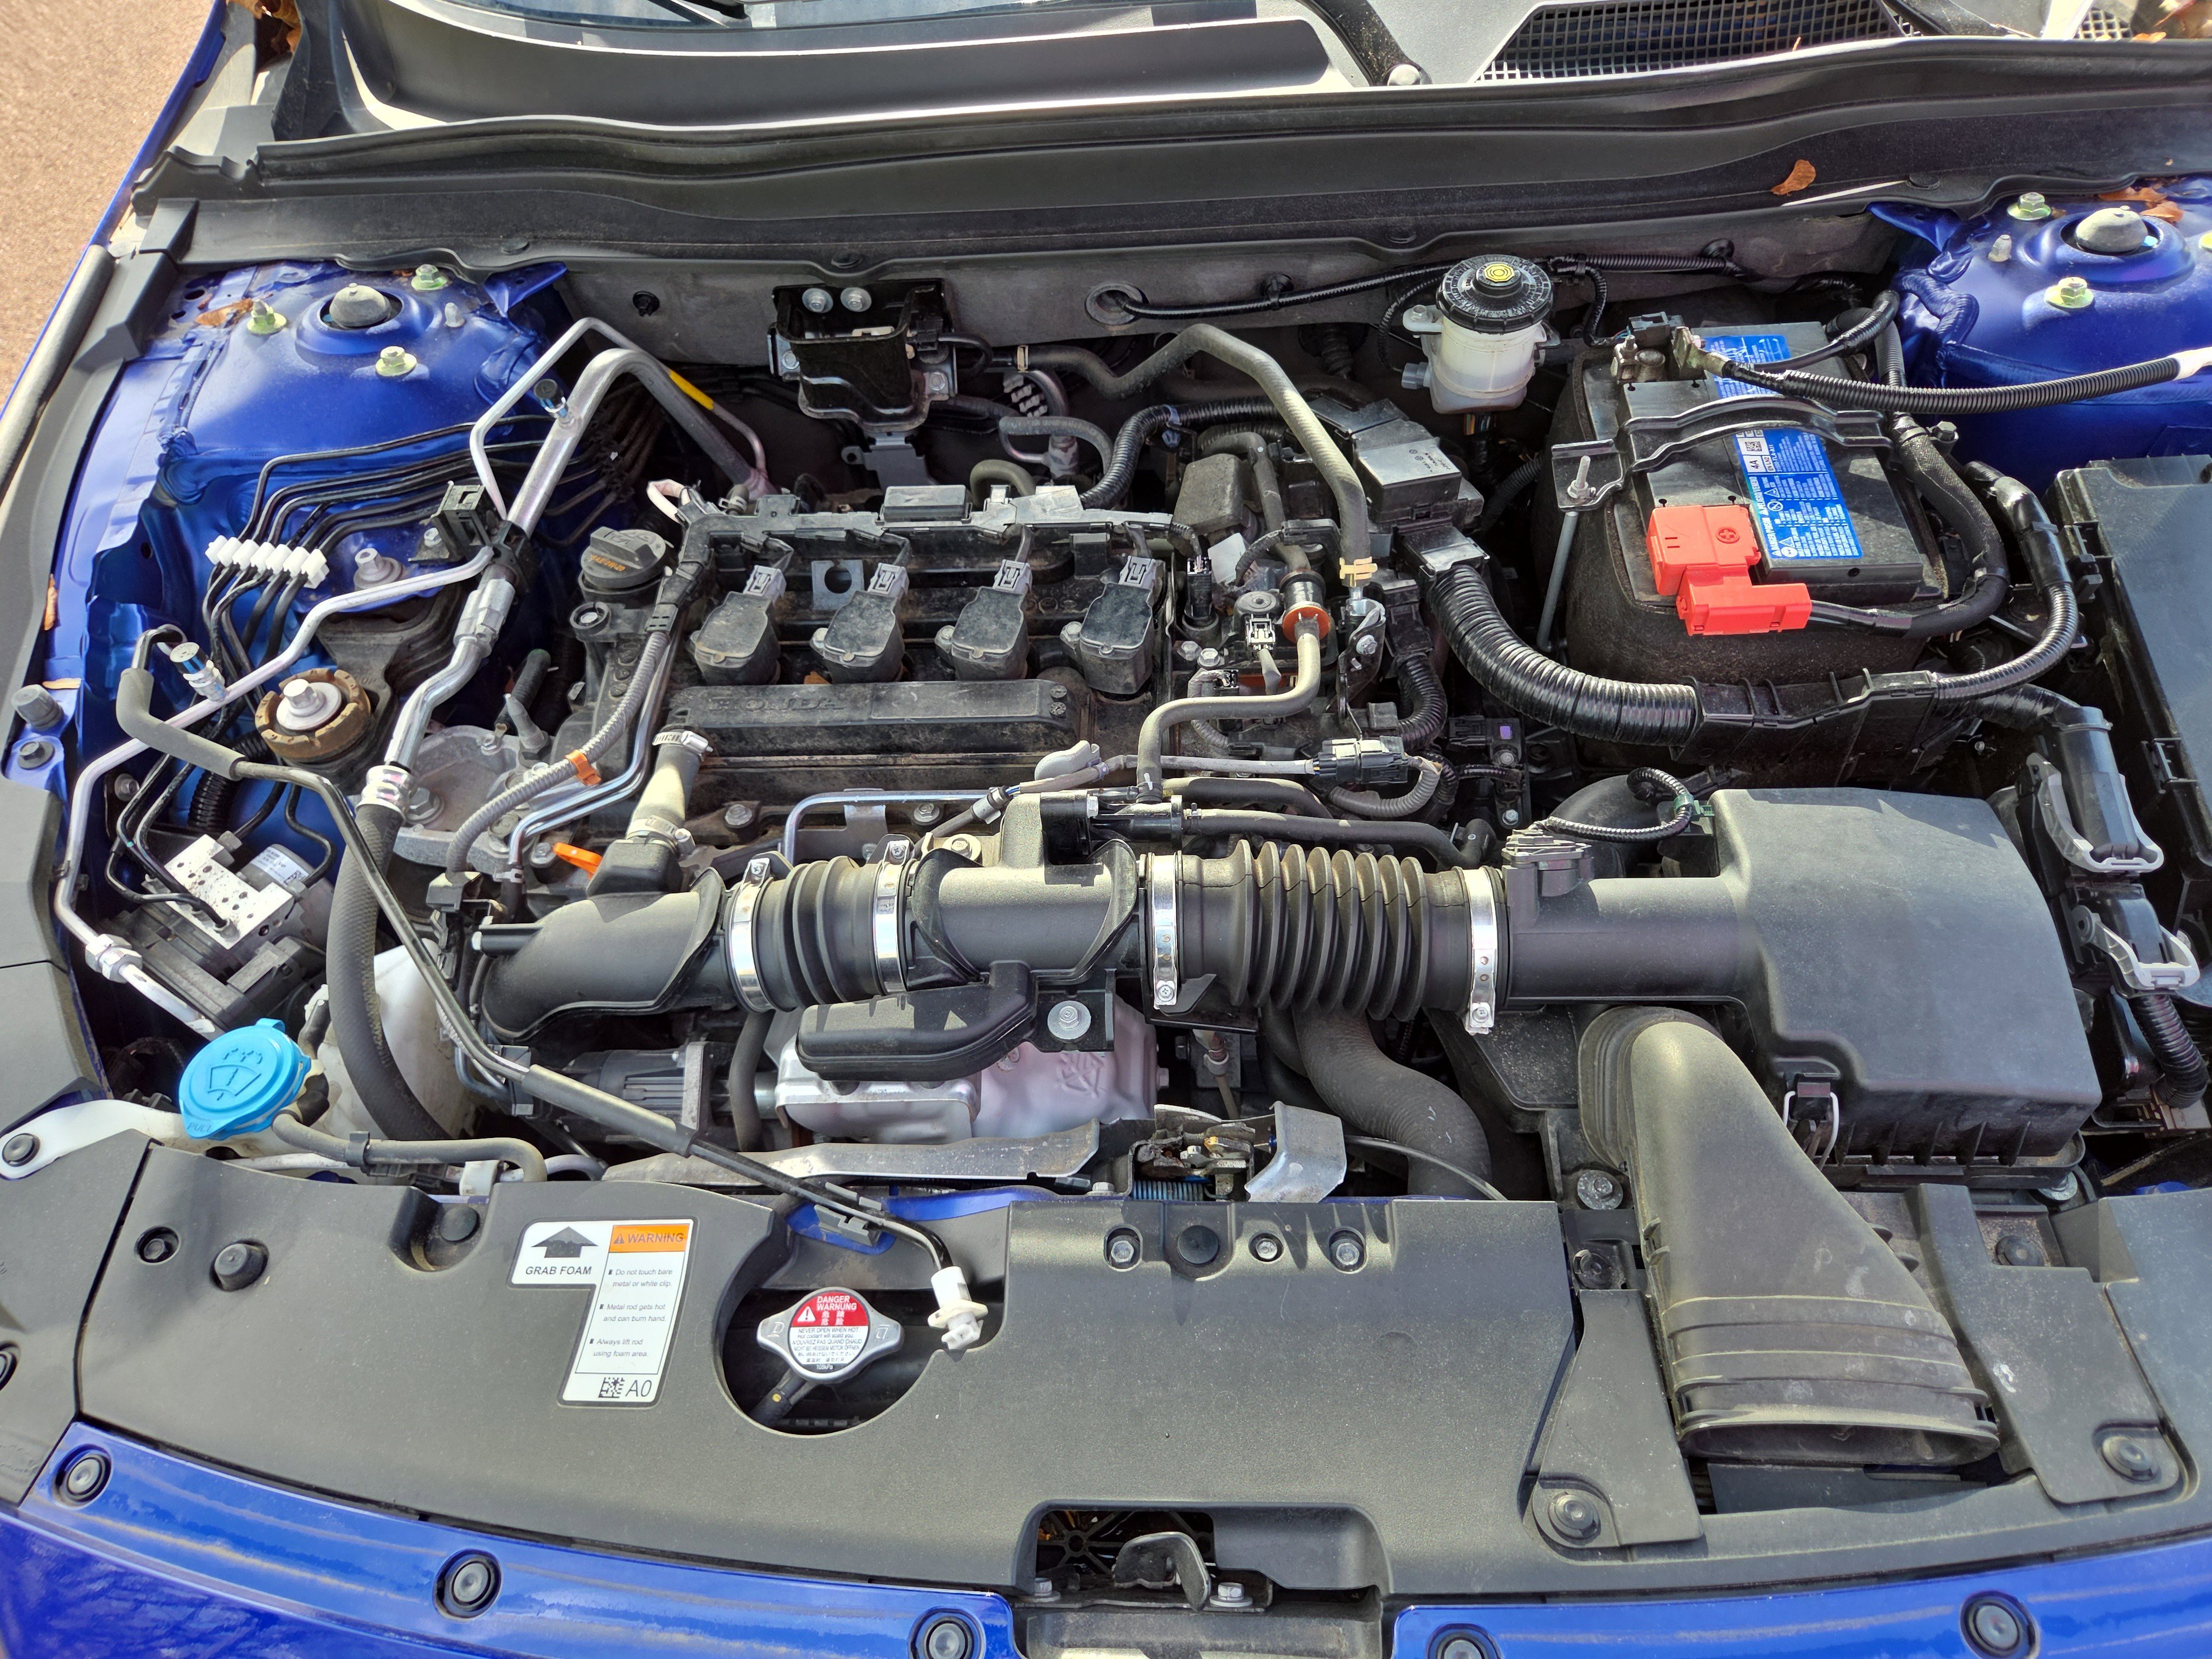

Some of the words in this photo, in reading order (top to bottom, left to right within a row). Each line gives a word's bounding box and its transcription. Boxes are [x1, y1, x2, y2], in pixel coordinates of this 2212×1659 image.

[1748, 459, 1760, 470] 4A
[627, 1233, 684, 1243] WARNING
[525, 1266, 557, 1275] GRAB
[559, 1266, 593, 1275] FOAM
[816, 1295, 850, 1303] DANGER
[625, 1379, 652, 1397] A0
